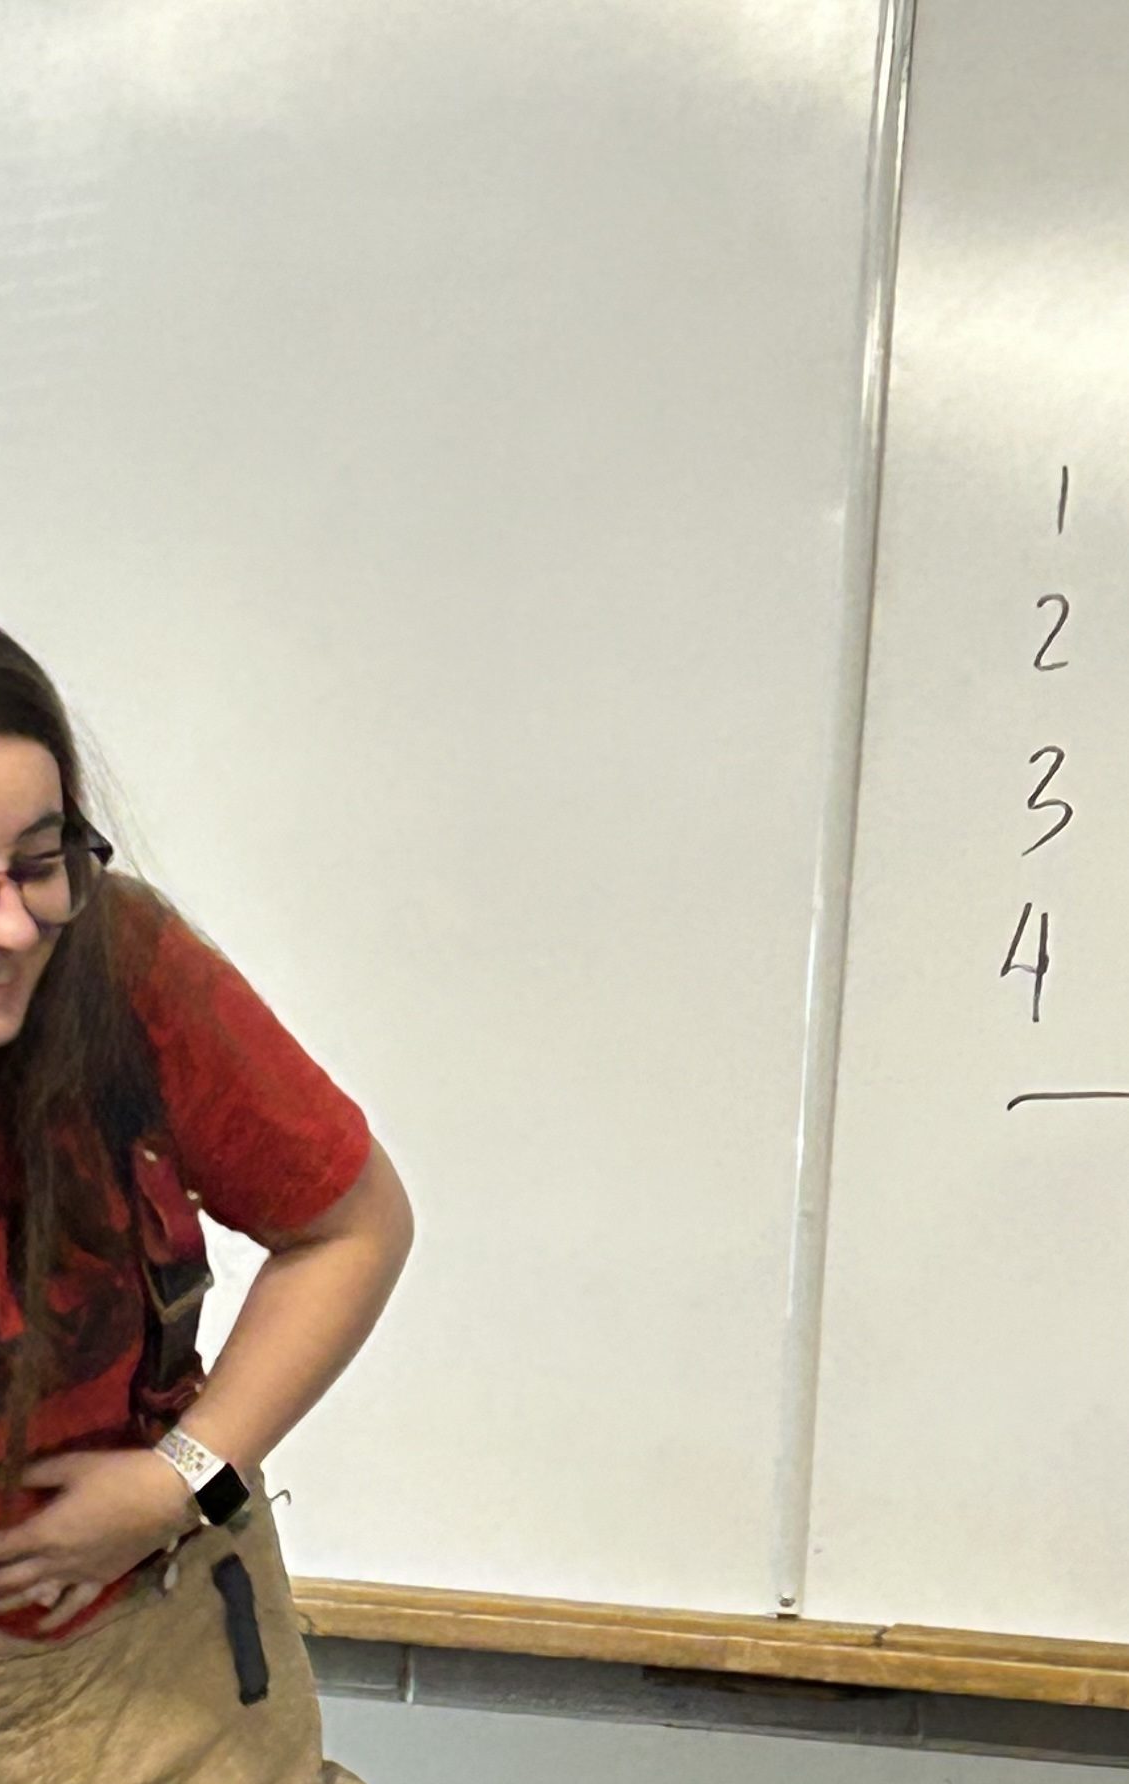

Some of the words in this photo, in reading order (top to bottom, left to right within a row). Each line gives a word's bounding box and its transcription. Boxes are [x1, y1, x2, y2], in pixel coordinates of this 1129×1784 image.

[1057, 465, 1069, 535] 1
[1033, 594, 1070, 671] 2
[1022, 746, 1074, 856] 3
[1000, 902, 1050, 1023] 4
